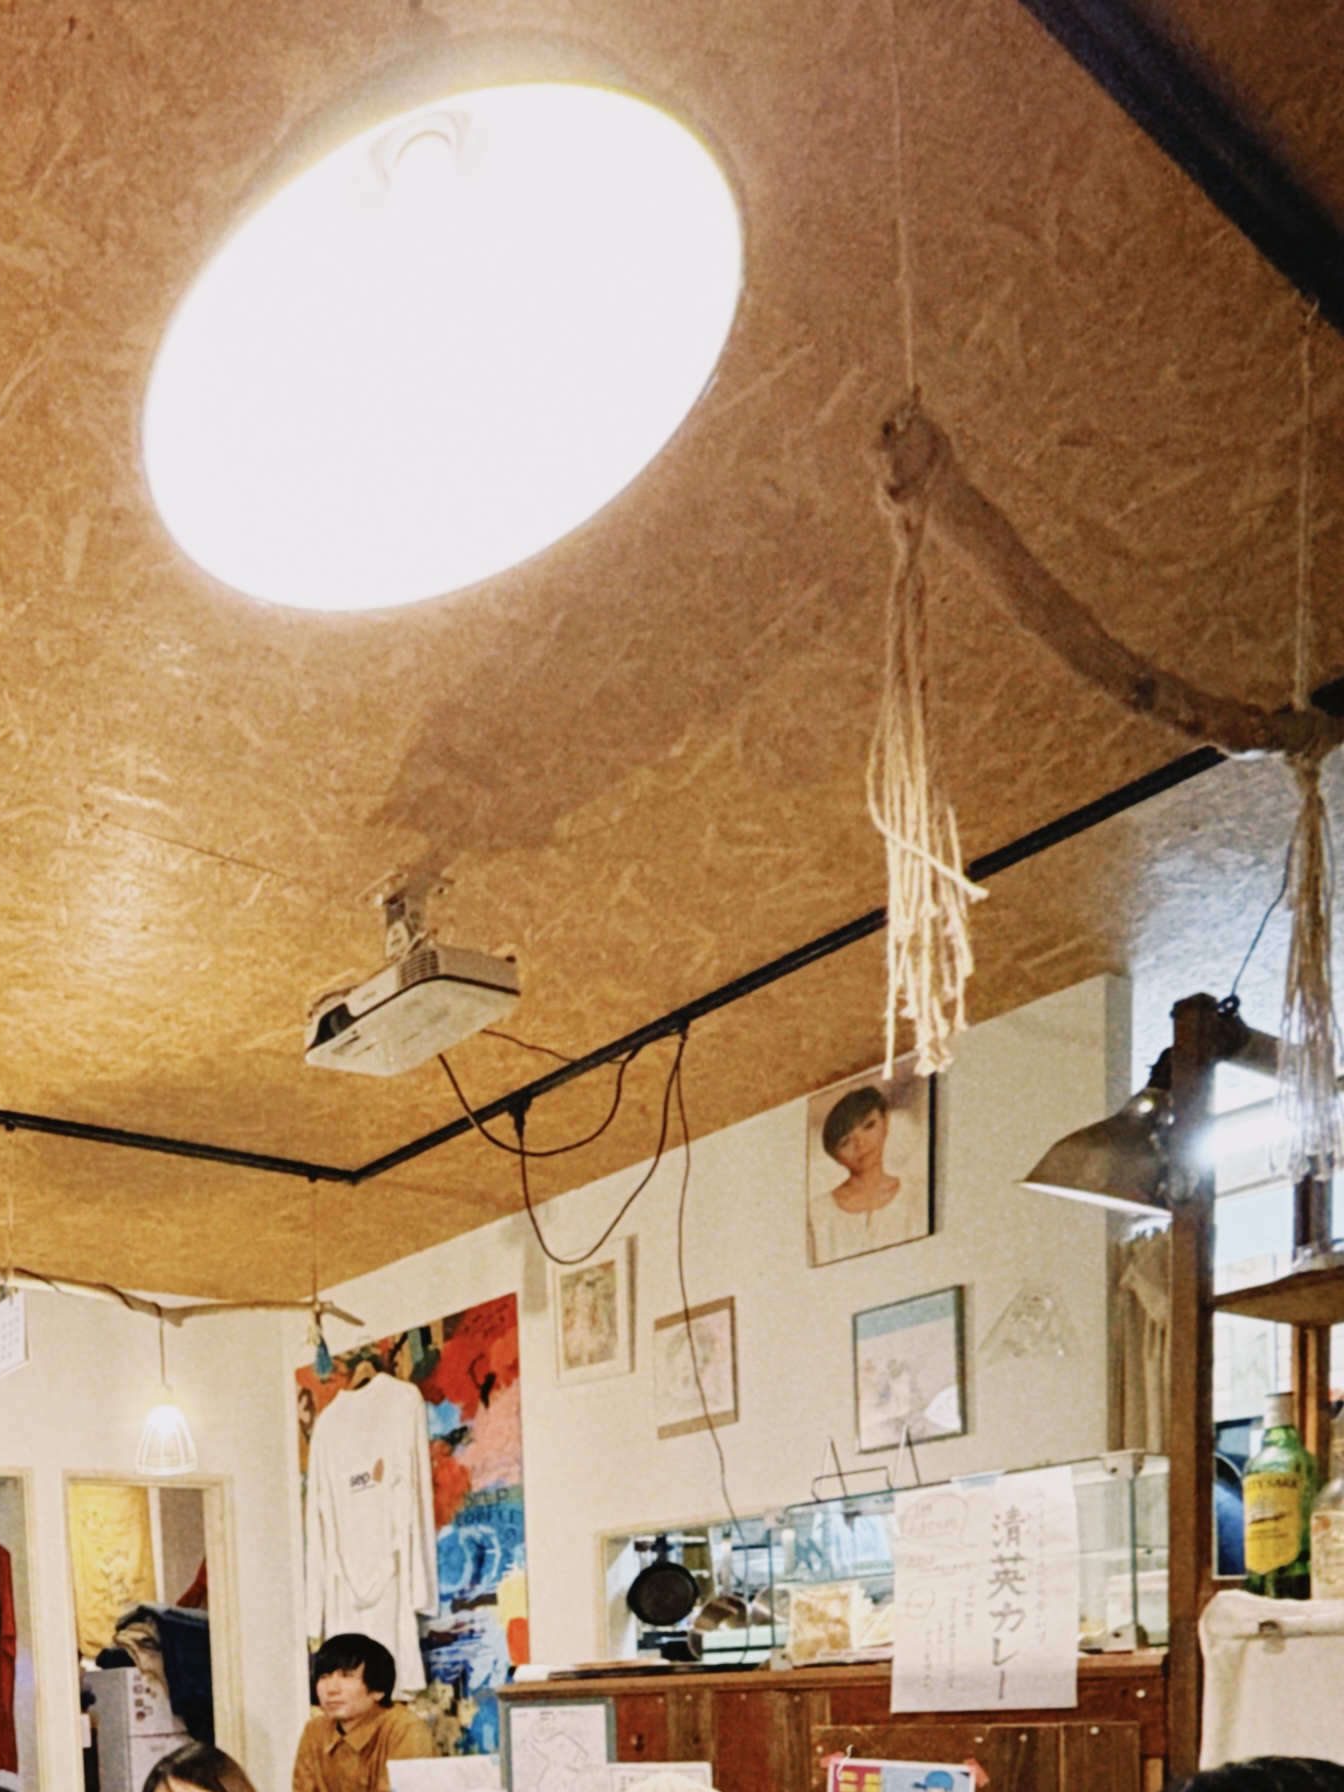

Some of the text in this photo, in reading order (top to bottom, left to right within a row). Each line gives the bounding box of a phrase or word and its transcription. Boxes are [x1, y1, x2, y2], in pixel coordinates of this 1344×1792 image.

[987, 1505, 1028, 1701] 清英カレー
